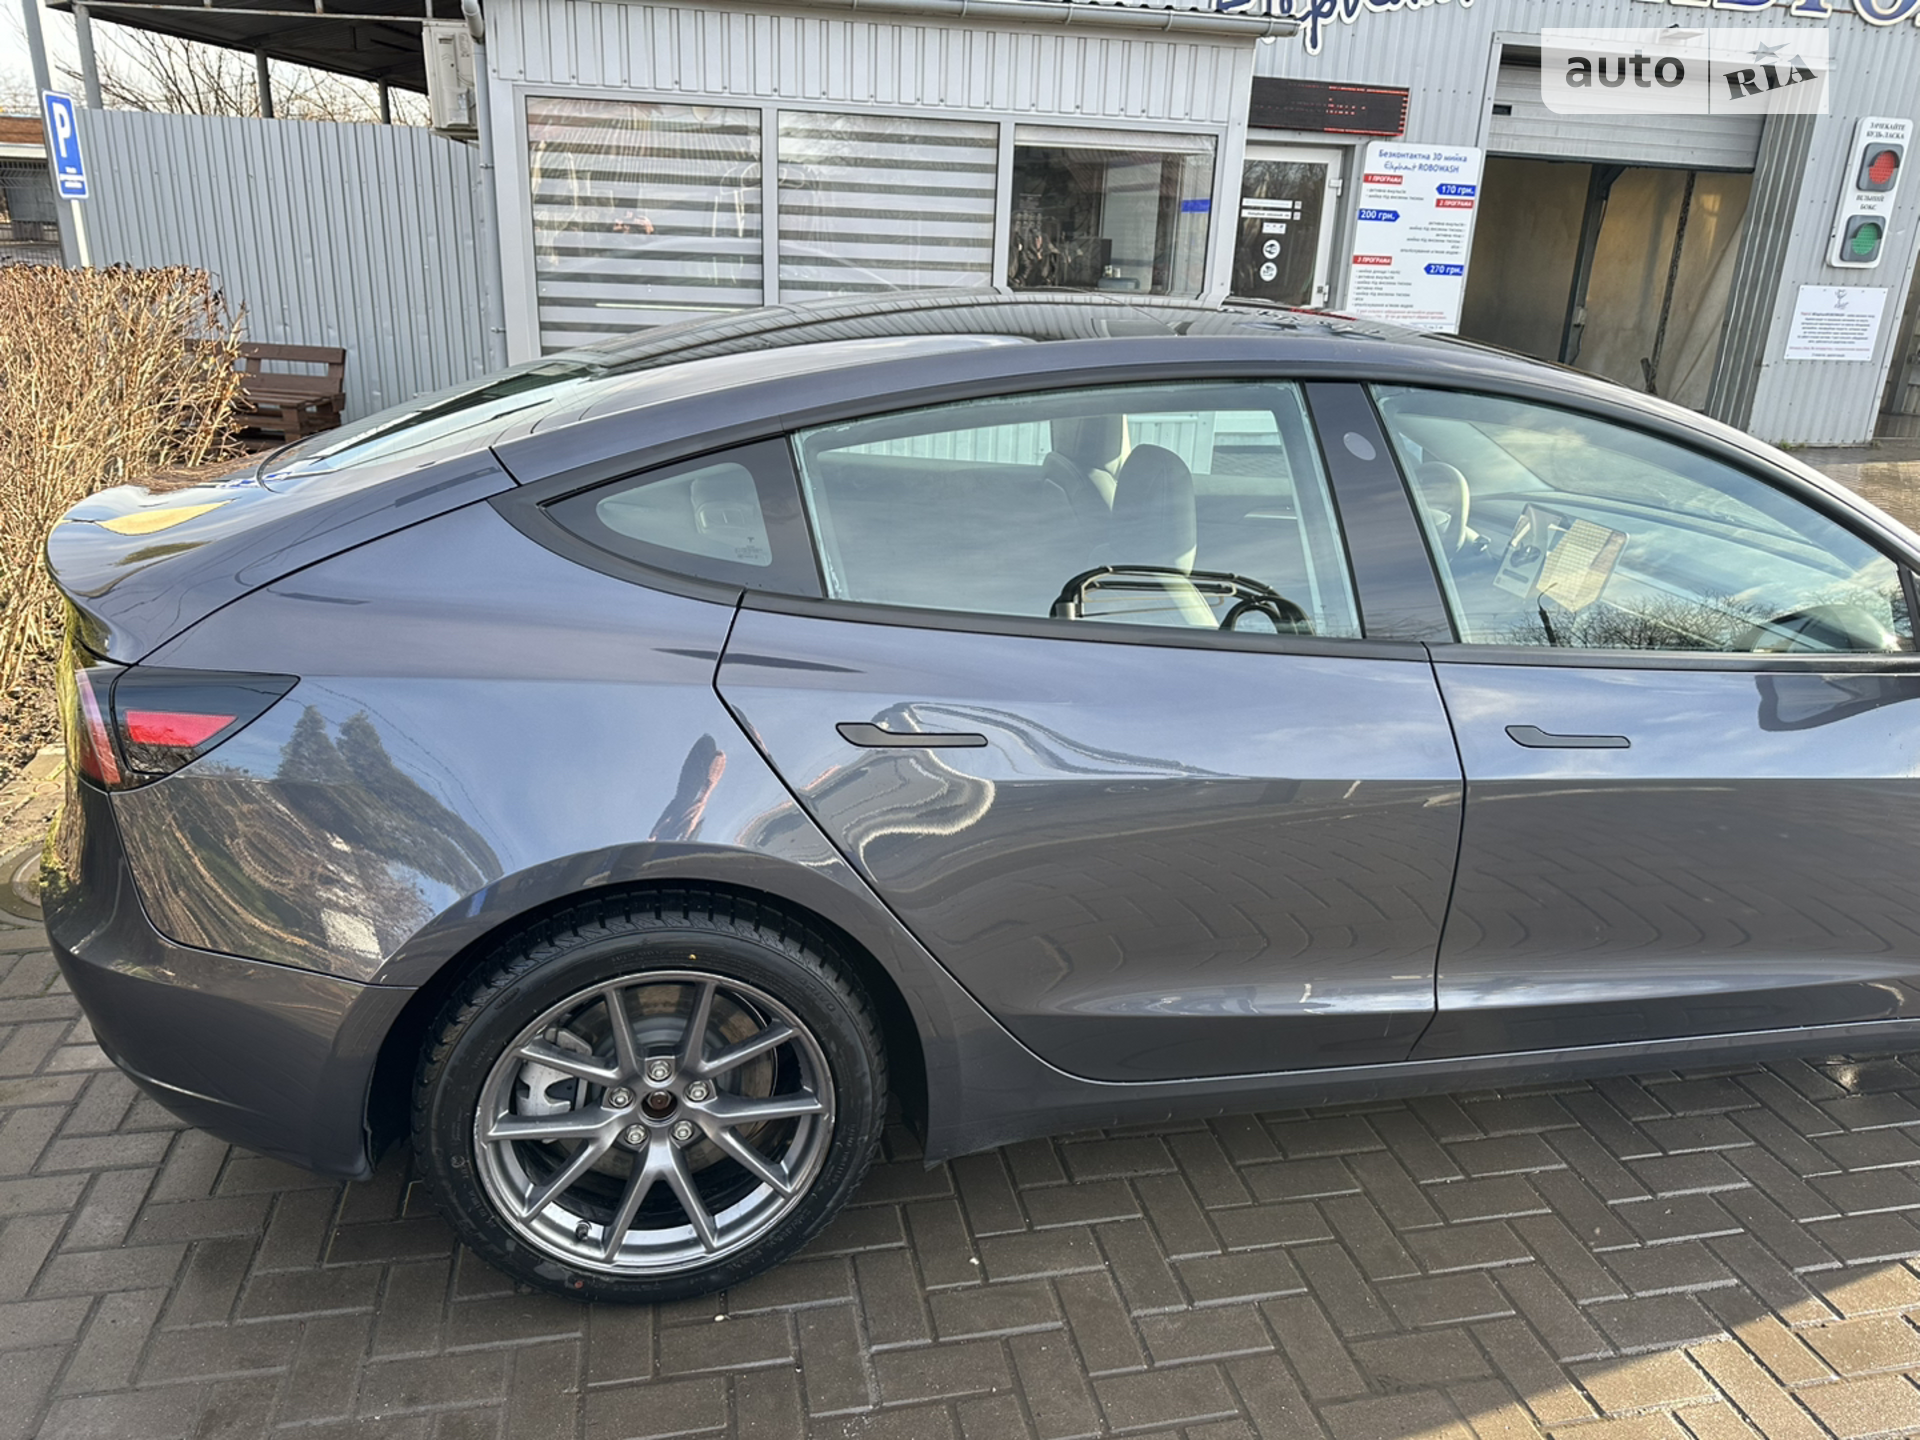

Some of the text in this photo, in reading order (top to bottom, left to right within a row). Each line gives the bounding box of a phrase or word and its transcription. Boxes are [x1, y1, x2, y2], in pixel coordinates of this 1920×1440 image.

[52, 102, 71, 158] P
[1378, 149, 1431, 161] Безконтактна
[1443, 153, 1468, 162] мийка
[1418, 163, 1460, 173] ROBOWASH
[1441, 185, 1475, 195] 170 грн.
[1361, 210, 1396, 220] 200 грн.
[1361, 256, 1391, 264] ПРОГРАМА
[1430, 265, 1463, 275] 270 грн.
